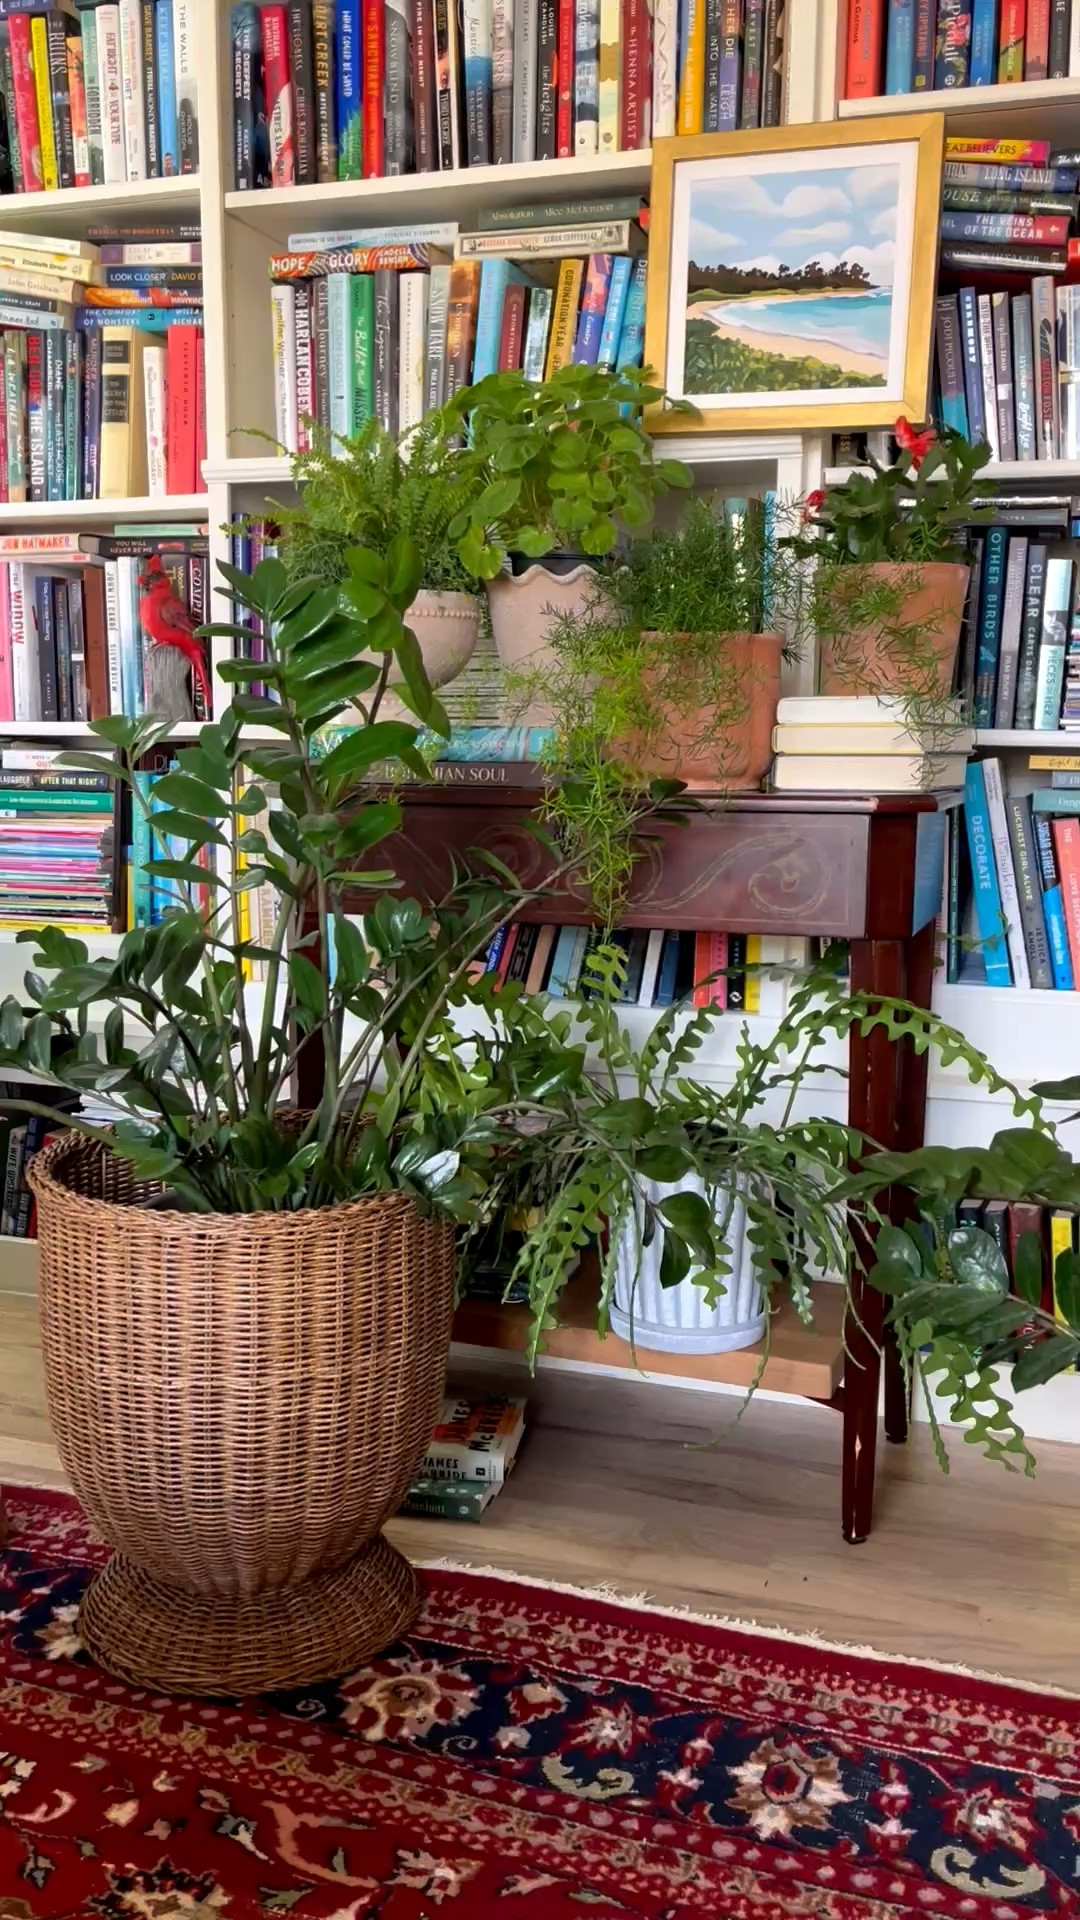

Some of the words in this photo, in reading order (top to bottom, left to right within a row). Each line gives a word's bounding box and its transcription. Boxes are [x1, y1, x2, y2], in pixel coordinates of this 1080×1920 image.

[144, 4, 153, 27] DAVE
[179, 4, 187, 29] THE
[292, 8, 302, 25] THE
[315, 5, 328, 37] DIRT
[342, 10, 352, 33] WHAT
[417, 26, 424, 36] IN
[547, 7, 555, 37] LOUISE
[726, 8, 736, 34] HER
[144, 28, 154, 62] RAMSEY
[709, 35, 718, 61] INTO
[725, 38, 735, 59] DIE
[916, 12, 930, 58] UPSTAIRS
[943, 4, 963, 64] Picoult
[49, 32, 67, 75] RUINS
[107, 48, 119, 75] RIGHT
[180, 33, 188, 74] WALLS
[317, 42, 329, 87] CREEK
[342, 62, 352, 72] BE
[367, 26, 380, 97] SANCTUARY
[389, 20, 401, 104] SNOWBLIND
[628, 38, 637, 89] HENNA
[235, 50, 243, 99] SECRETS
[242, 52, 251, 101] DEEPEST
[542, 66, 552, 80] the
[709, 66, 718, 87] THE
[87, 86, 102, 135] FORBIDDEN
[109, 100, 120, 124] YOUR
[147, 93, 155, 124] MONEY
[296, 87, 306, 119] CHRIS
[319, 92, 328, 120] HAYLEY
[540, 83, 554, 135] heights
[626, 92, 637, 139] ARTIST
[708, 92, 718, 128] WATER
[720, 84, 731, 120] LEIGH
[111, 124, 121, 145] TYPE
[476, 111, 485, 143] CABOT
[967, 144, 1017, 155] BELIEVERS
[984, 167, 1012, 181] LONG
[1014, 168, 1053, 184] ISLAND
[964, 226, 978, 236] OF
[981, 226, 1003, 236] THE
[1005, 228, 1044, 239] OCEAN
[975, 215, 994, 224] THE
[110, 273, 133, 282] LOOK
[134, 272, 166, 282] CLOSER
[171, 272, 196, 281] DAVID
[272, 258, 306, 272] HOPE
[329, 252, 370, 269] GLORY
[635, 259, 648, 288] DEEP
[317, 280, 329, 326] Cilka's
[375, 289, 391, 318] The
[430, 290, 447, 325] SNOW
[558, 269, 575, 324] CORONATION
[83, 319, 94, 327] OF
[274, 297, 284, 340] Jennifer
[452, 303, 464, 358] UNBROKEN
[940, 316, 955, 341] JODI
[27, 336, 42, 365] BEN
[295, 308, 311, 367] HARLAN
[354, 329, 368, 368] Bullet
[374, 319, 391, 373] Ingenue
[428, 328, 446, 361] HARE
[555, 325, 567, 348] YEAR
[276, 340, 287, 378] Weiner
[316, 328, 330, 379] Journey
[943, 343, 957, 387] PICOULT
[55, 359, 64, 391] DIANE
[295, 366, 312, 414] COBEN
[30, 410, 44, 434] THE
[354, 387, 368, 430] MISSED
[30, 438, 45, 485] ISLAND
[2, 537, 20, 551] JEN
[21, 536, 74, 550] HATMAKER
[987, 533, 1002, 585] OTHER
[106, 571, 114, 593] JOHN
[1026, 564, 1042, 617] CLEAR
[107, 595, 114, 603] LE
[12, 590, 24, 645] WIDOW
[983, 594, 998, 639] BIRDS
[1025, 626, 1035, 657] CARYS
[1045, 648, 1058, 684] PIECES
[40, 776, 60, 785] AFTER
[62, 777, 77, 786] THAT
[78, 778, 98, 787] NIGHT
[469, 768, 509, 783] SOUL
[1012, 805, 1026, 848] LUCKIEST
[1036, 821, 1051, 848] SUGAR
[971, 814, 991, 890] DECORATE
[1019, 850, 1030, 872] GIRL
[1040, 849, 1056, 880] STREET
[1062, 826, 1073, 844] THE
[1068, 872, 1080, 896] LOVE
[1022, 873, 1034, 902] ALIVE
[1027, 930, 1037, 962] KNOLL
[1035, 926, 1046, 965] JESSICA
[8, 1147, 19, 1169] WIFE
